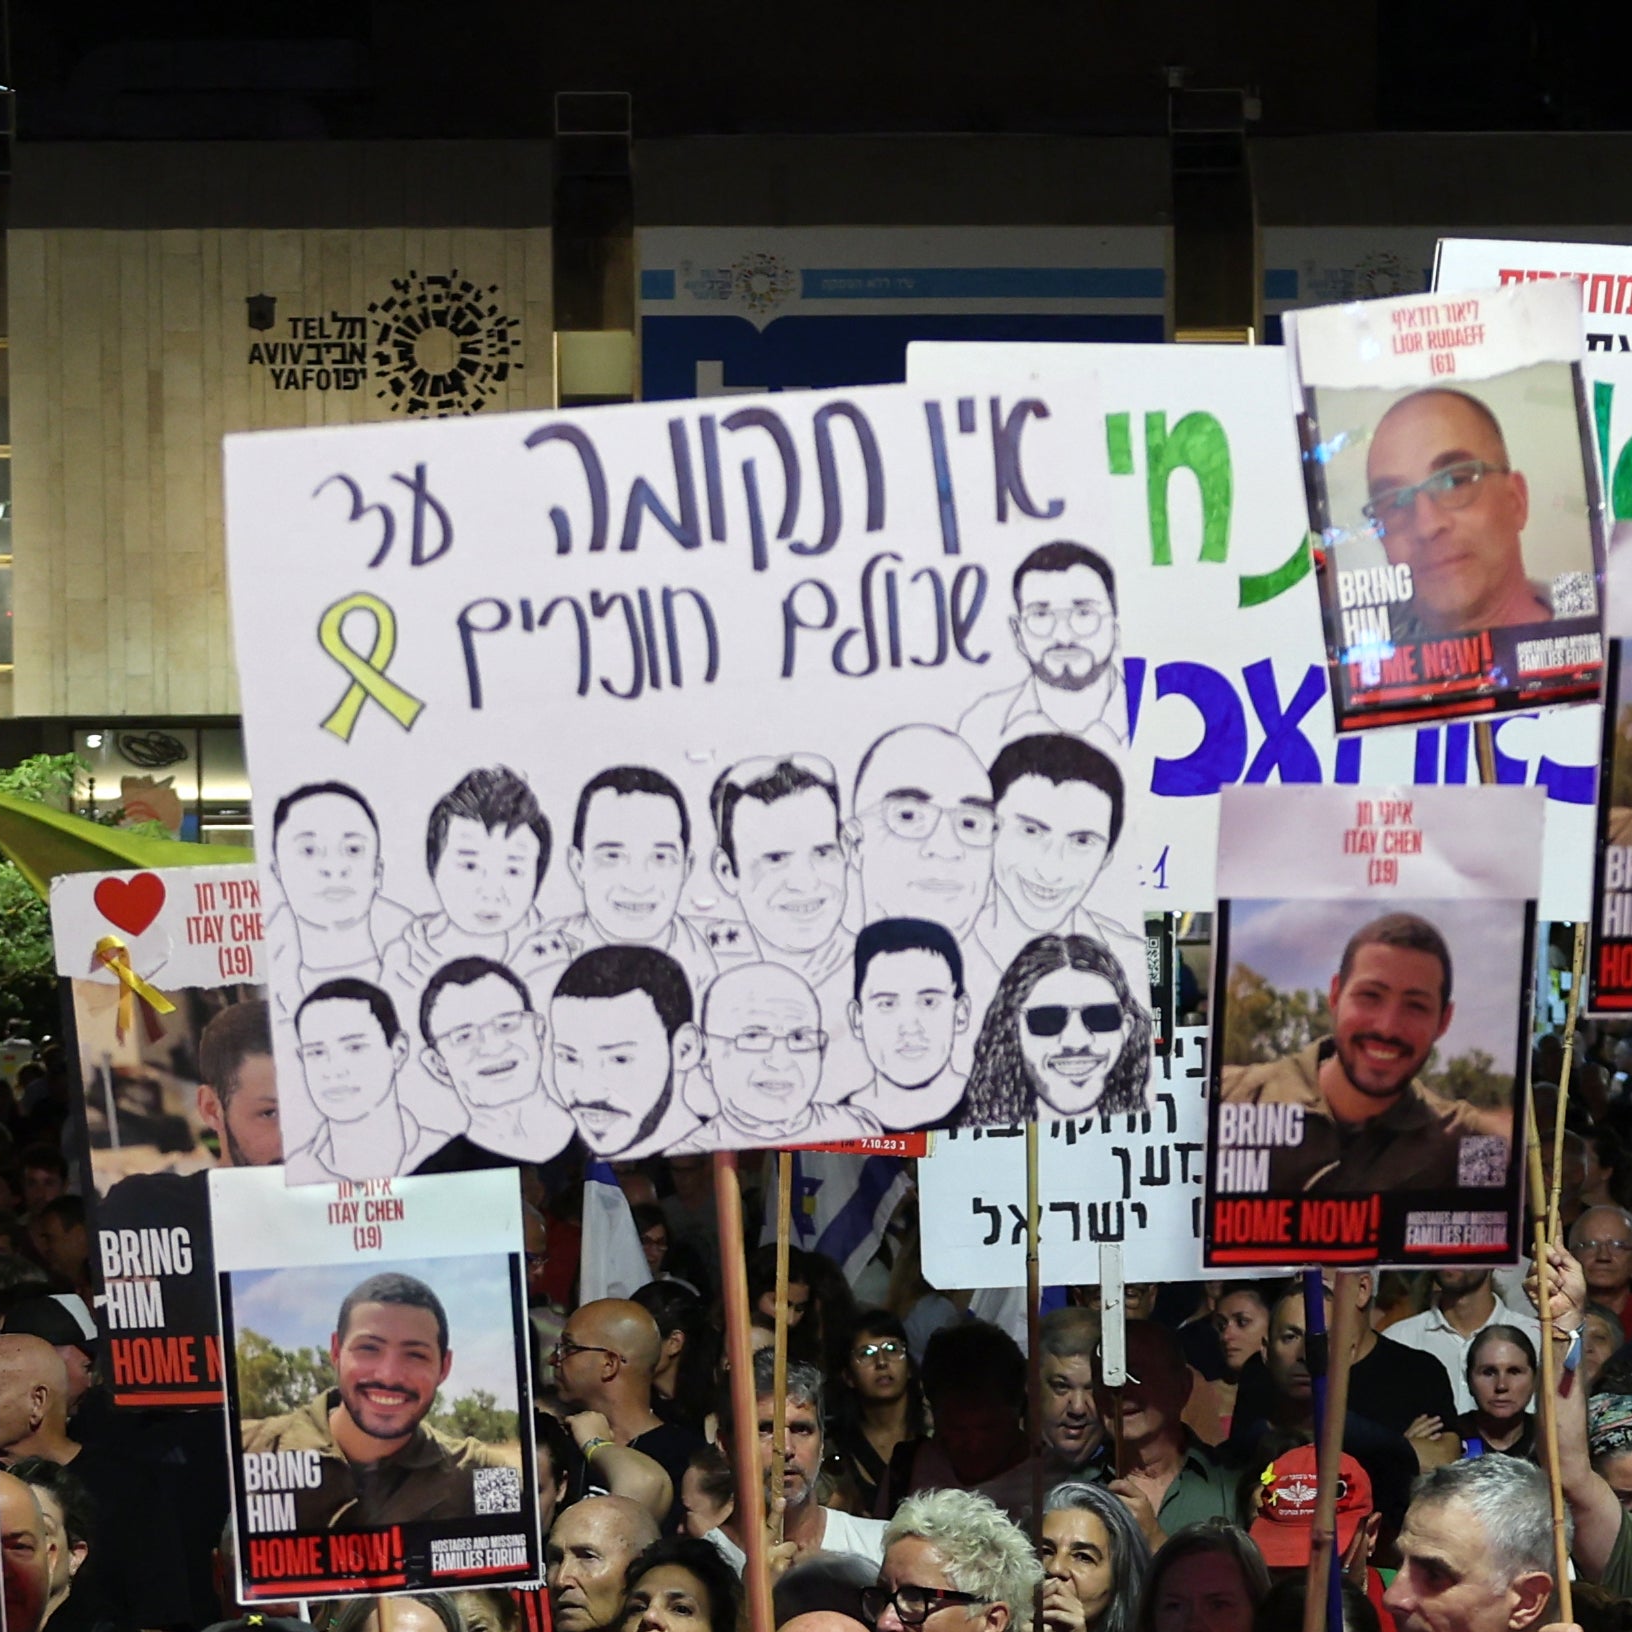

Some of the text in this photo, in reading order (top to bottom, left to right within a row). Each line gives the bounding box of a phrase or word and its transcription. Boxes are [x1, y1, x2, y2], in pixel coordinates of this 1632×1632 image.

[331, 311, 367, 339] תל
[1442, 300, 1480, 324] ליאור
[288, 317, 331, 339] TEL
[1392, 325, 1486, 355] LIOR RUDAEFF
[249, 343, 303, 364] AVIV
[306, 343, 367, 364] אביב
[1430, 352, 1456, 376] (61)
[270, 368, 332, 390] YAFO
[332, 368, 367, 390] יפו
[522, 401, 889, 573] תקומה
[925, 395, 1067, 555] אין
[311, 461, 456, 570] עד
[1337, 563, 1414, 605] BRING
[454, 552, 993, 711] שכולם חוזרים
[1342, 606, 1391, 647] HIM
[1421, 630, 1493, 680] NOW!
[1518, 644, 1602, 671] FAMILIES FORUM
[1355, 801, 1414, 827] איתי חן
[1343, 829, 1422, 855] ITAY CHEN
[1368, 858, 1399, 887] (19)
[194, 882, 217, 912] חן
[186, 914, 224, 945] ITAY
[217, 945, 254, 978] (19)
[1219, 1103, 1304, 1146] BRING
[861, 1138, 896, 1150] 7.10.23
[1216, 1150, 1269, 1193] HIM
[329, 1199, 404, 1224] ITAY CHEN
[973, 1197, 1147, 1244] ישראל
[1213, 1195, 1380, 1244] HOME NOW!
[354, 1225, 382, 1251] (19)
[1405, 1224, 1461, 1248] FAMILIES
[98, 1226, 193, 1279] BRING
[104, 1279, 166, 1331] HIM
[110, 1335, 199, 1386] HOME
[243, 1448, 322, 1494] BRING
[247, 1491, 297, 1534] HIM
[249, 1525, 404, 1580] HOME NOW!
[431, 1534, 527, 1554] HOSTAGES AND MISSING
[431, 1546, 528, 1574] FAMILIES FORUM
